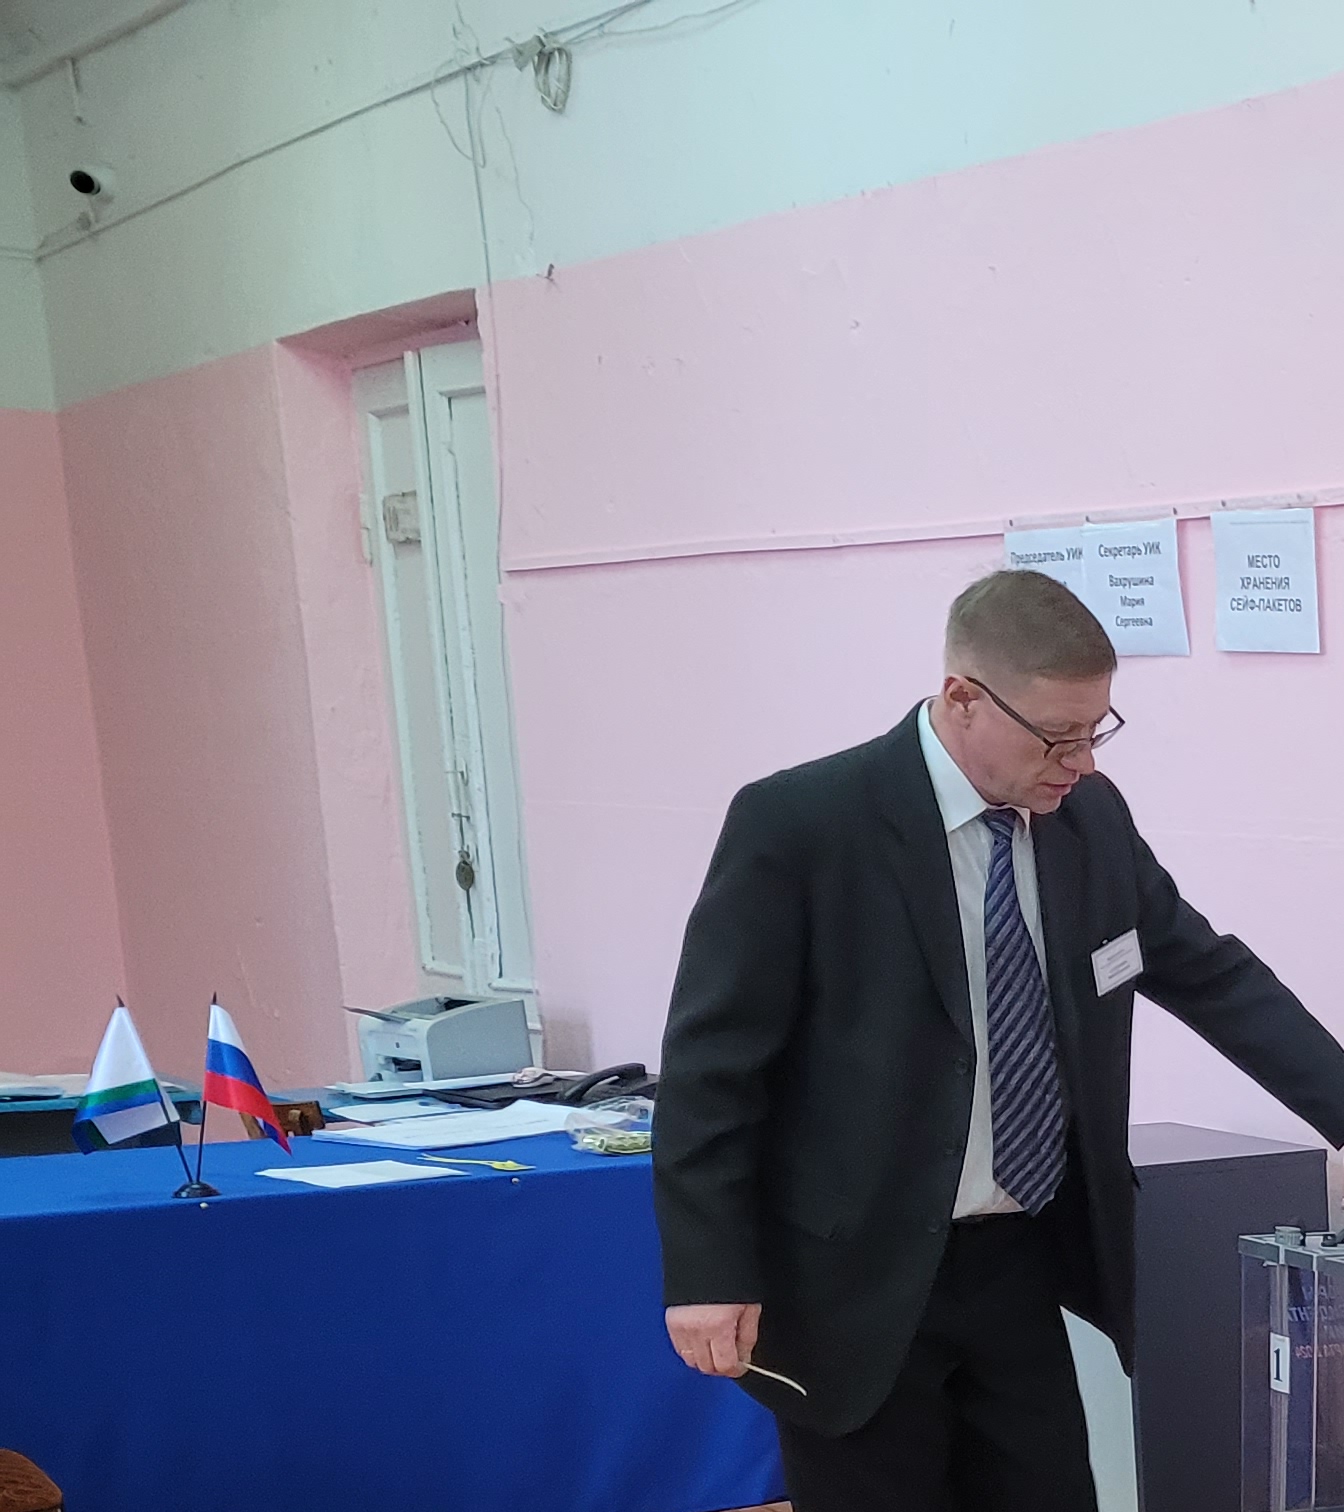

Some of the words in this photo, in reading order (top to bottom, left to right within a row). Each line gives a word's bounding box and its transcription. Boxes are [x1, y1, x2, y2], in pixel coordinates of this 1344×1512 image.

[1010, 551, 1065, 567] Председатель
[1098, 543, 1143, 562] Секретарь
[1142, 541, 1162, 556] УИК
[1247, 554, 1281, 569] МЕСТО
[1240, 576, 1290, 590] ХРАНЕНИЯ
[1120, 595, 1145, 608] Мария
[1230, 595, 1302, 612] СЕЙФ-ПАКЕТОВ
[1115, 615, 1153, 629] Сергеевна
[1273, 1348, 1283, 1382] 1
